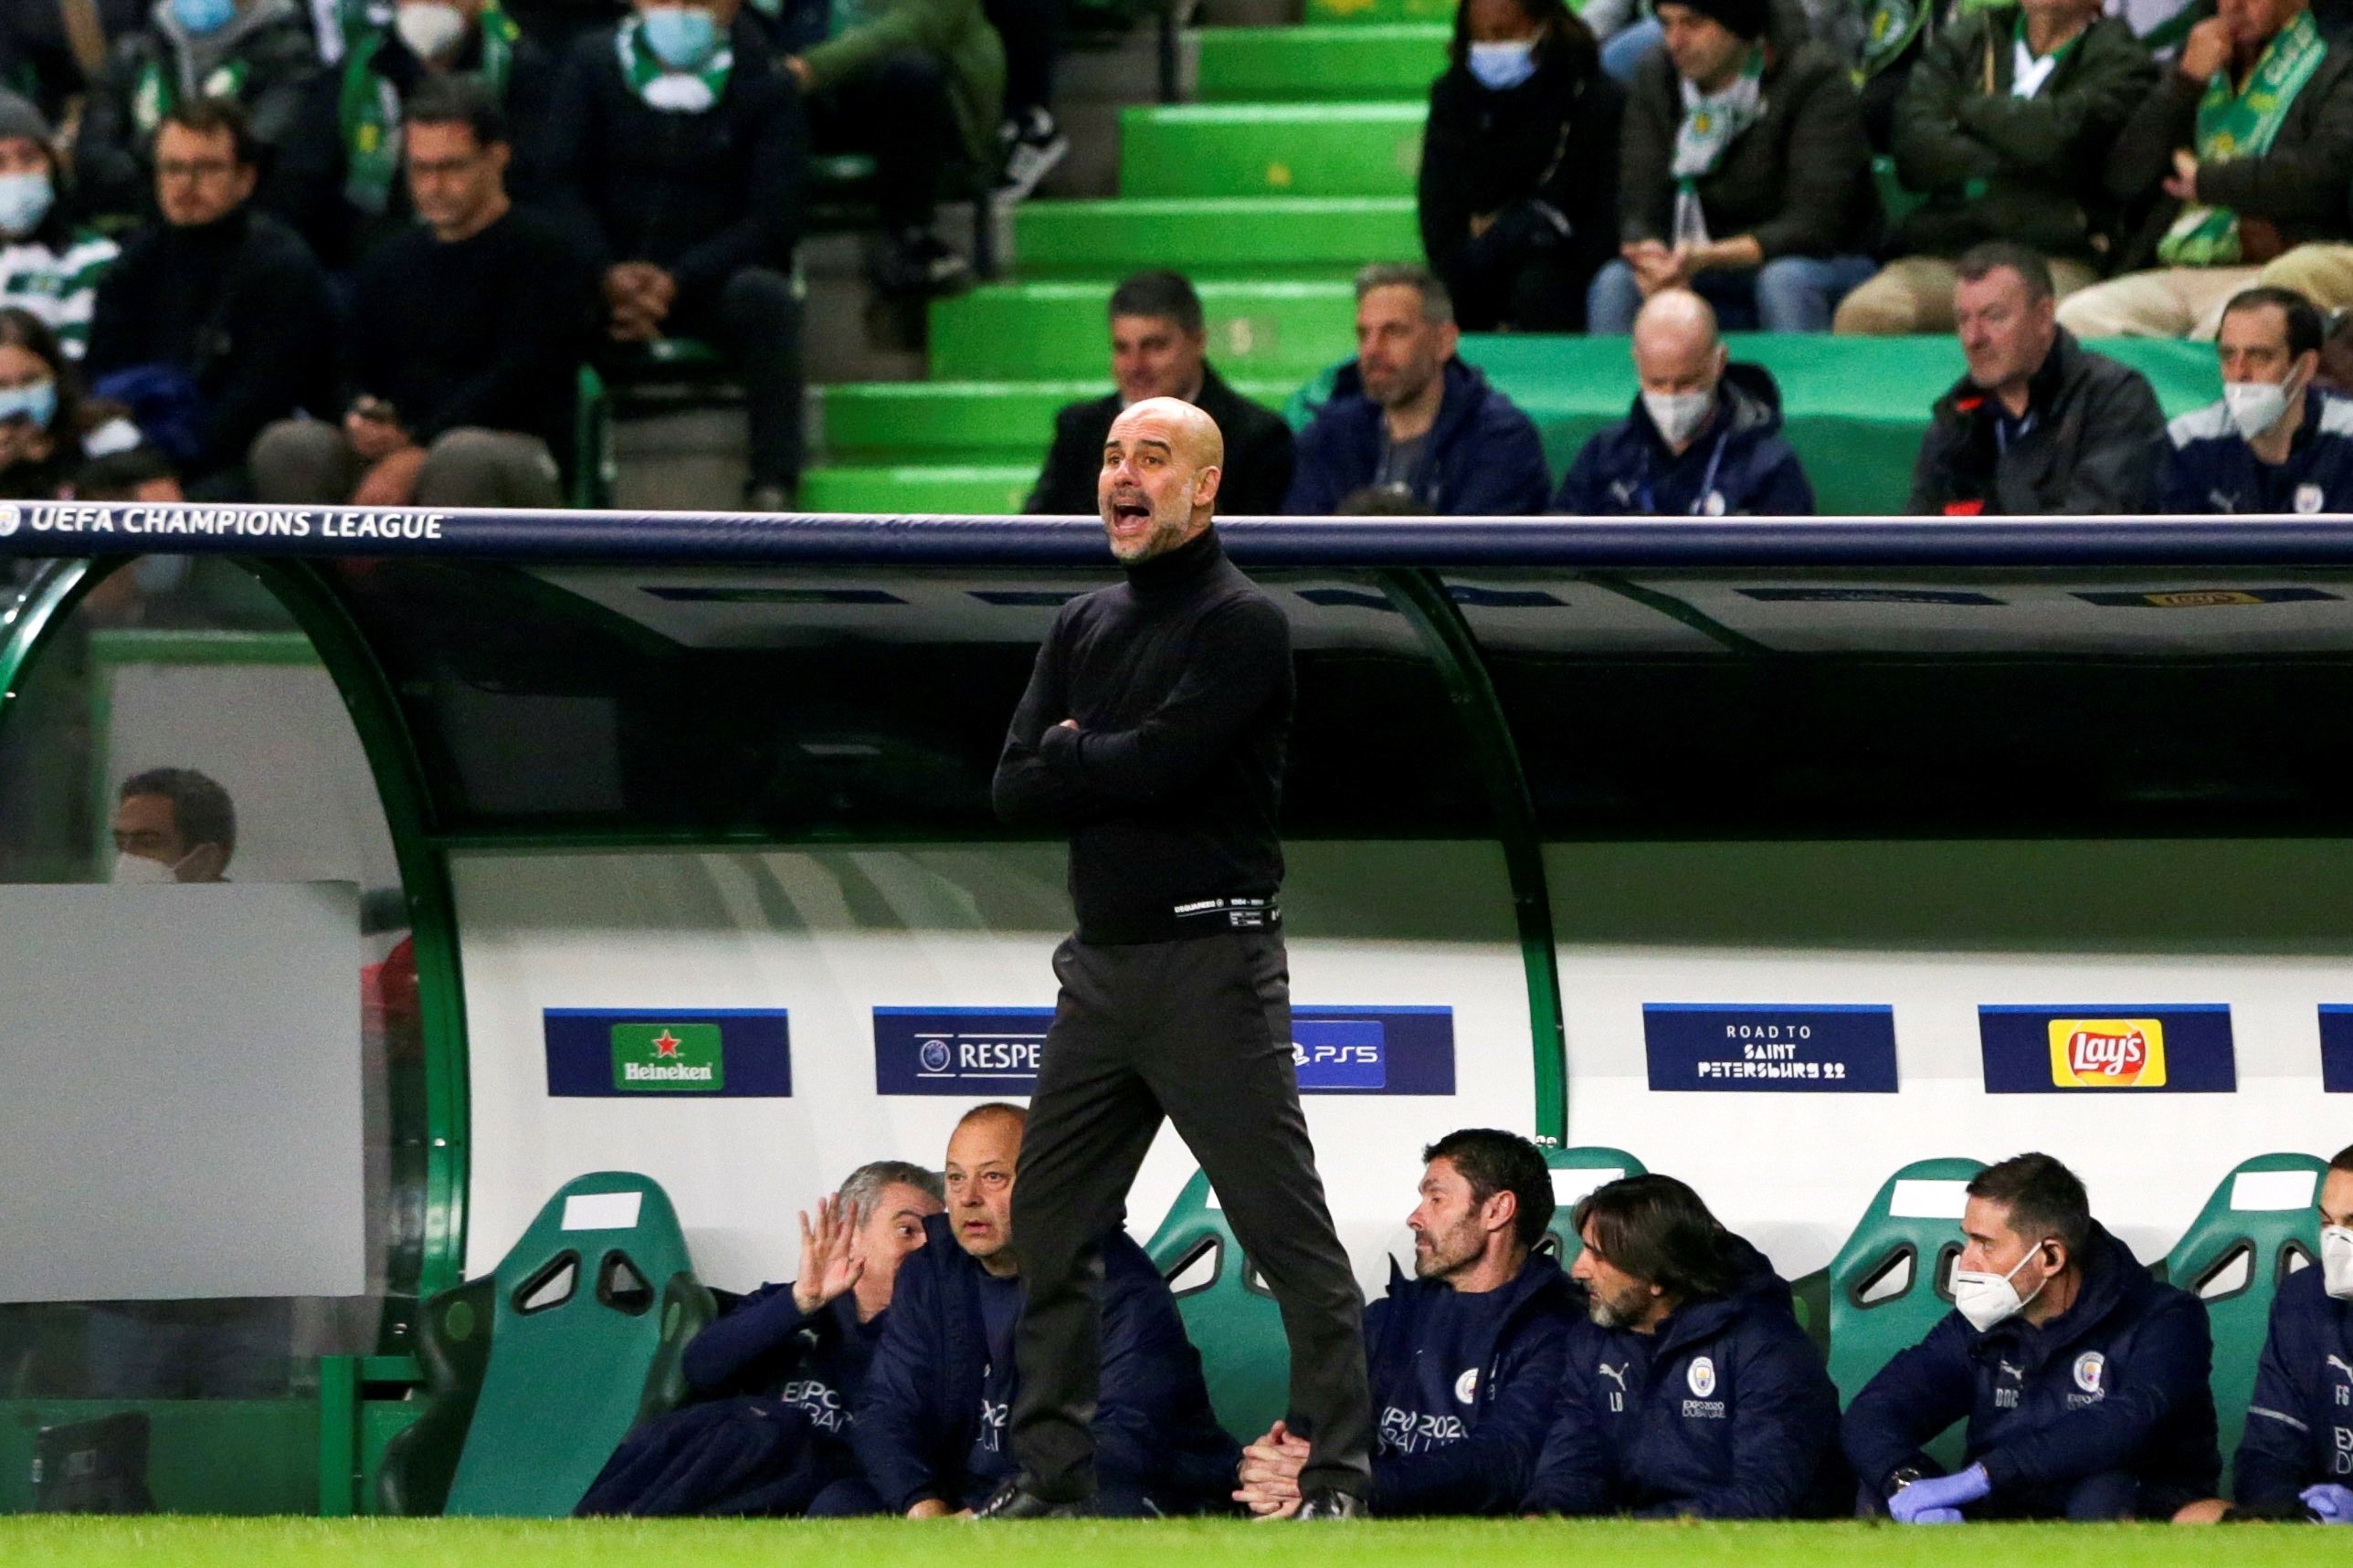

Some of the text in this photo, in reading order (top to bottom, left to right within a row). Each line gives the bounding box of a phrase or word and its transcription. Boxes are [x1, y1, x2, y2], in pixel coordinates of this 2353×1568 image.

[31, 507, 444, 540] UEFA CHAMPIONS LEAGUE
[1726, 1026, 1811, 1039] ROAD TO
[959, 1044, 1041, 1068] RESPE
[1314, 1046, 1378, 1063] PS5
[1744, 1043, 1797, 1060] SAINT
[2073, 1032, 2143, 1076] Lay's
[624, 1062, 712, 1080] Heineken
[1823, 1062, 1846, 1079] 22
